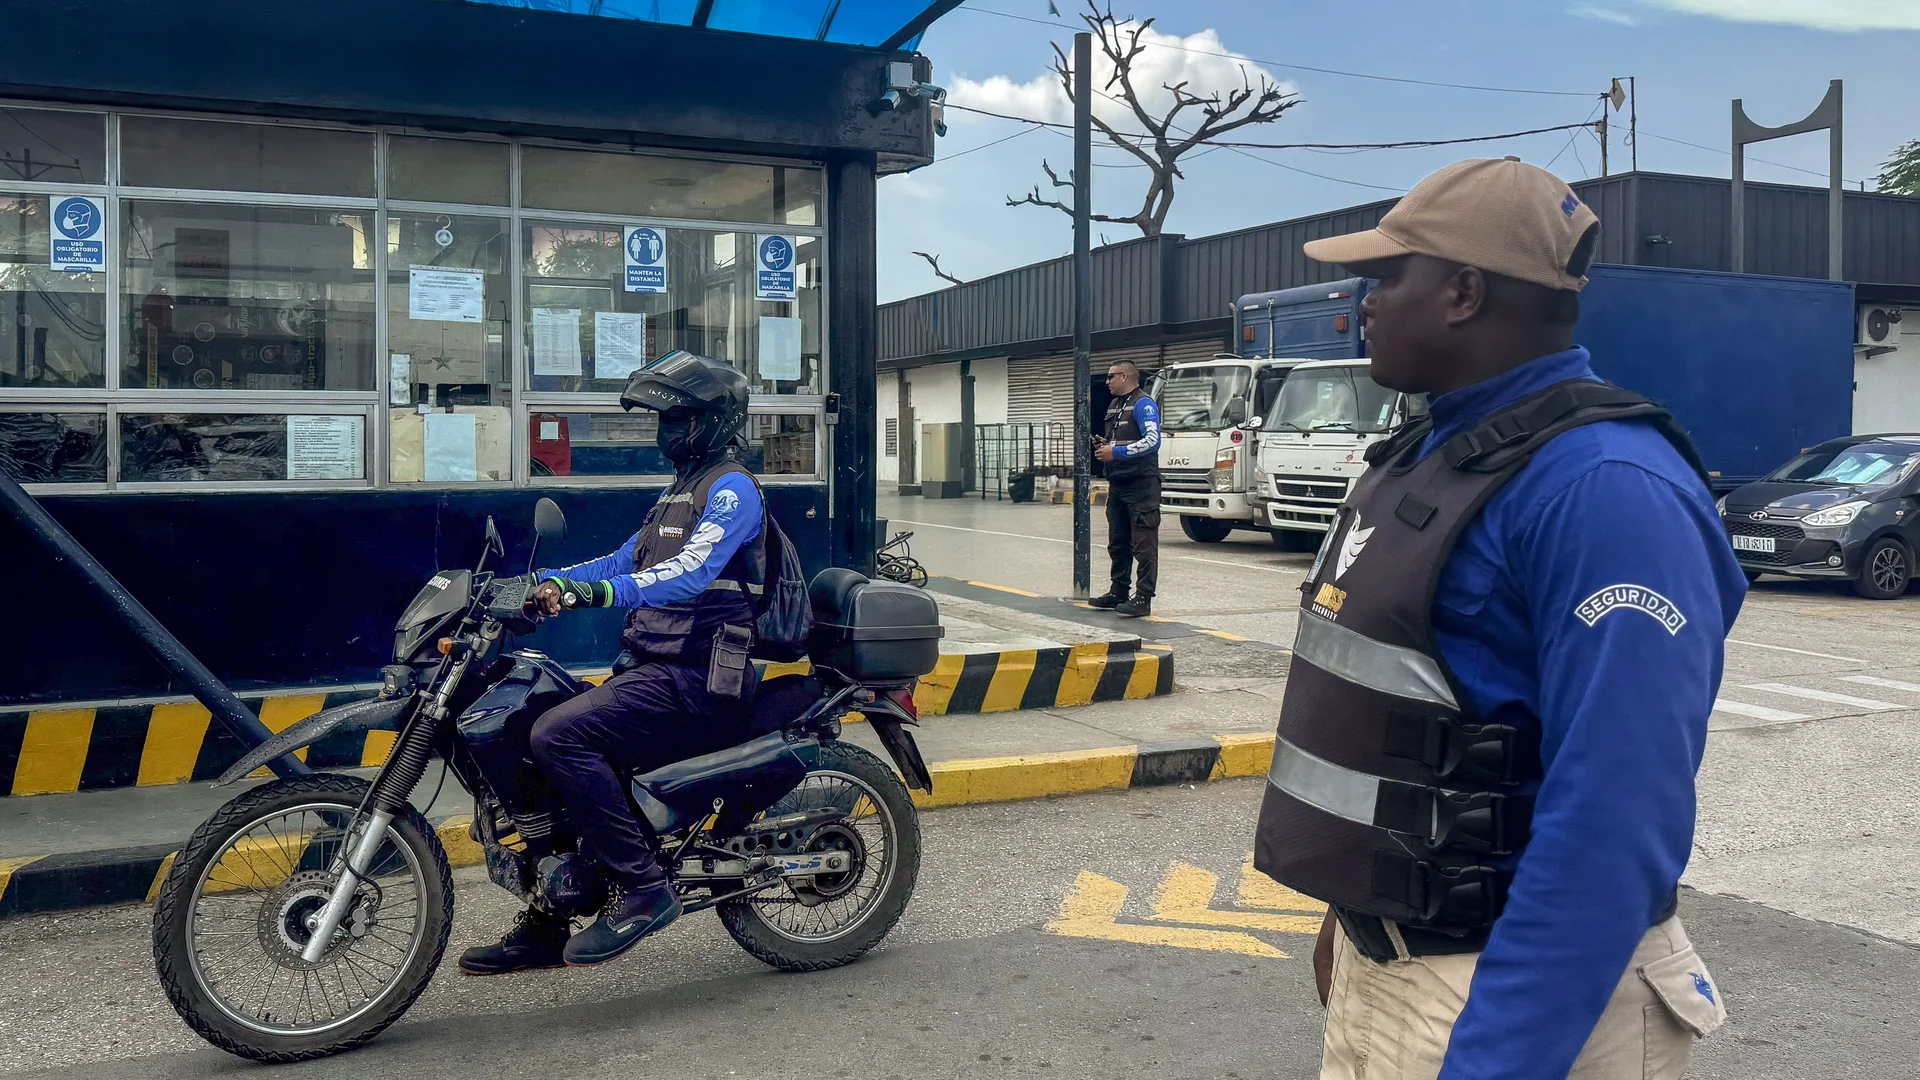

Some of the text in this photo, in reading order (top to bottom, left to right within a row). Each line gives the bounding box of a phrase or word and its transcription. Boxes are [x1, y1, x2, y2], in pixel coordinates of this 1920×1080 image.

[1167, 457, 1190, 466] JAC
[663, 526, 684, 535] MOSS
[1313, 582, 1347, 613] MOSS
[1581, 588, 1680, 628] SEGURIDAD
